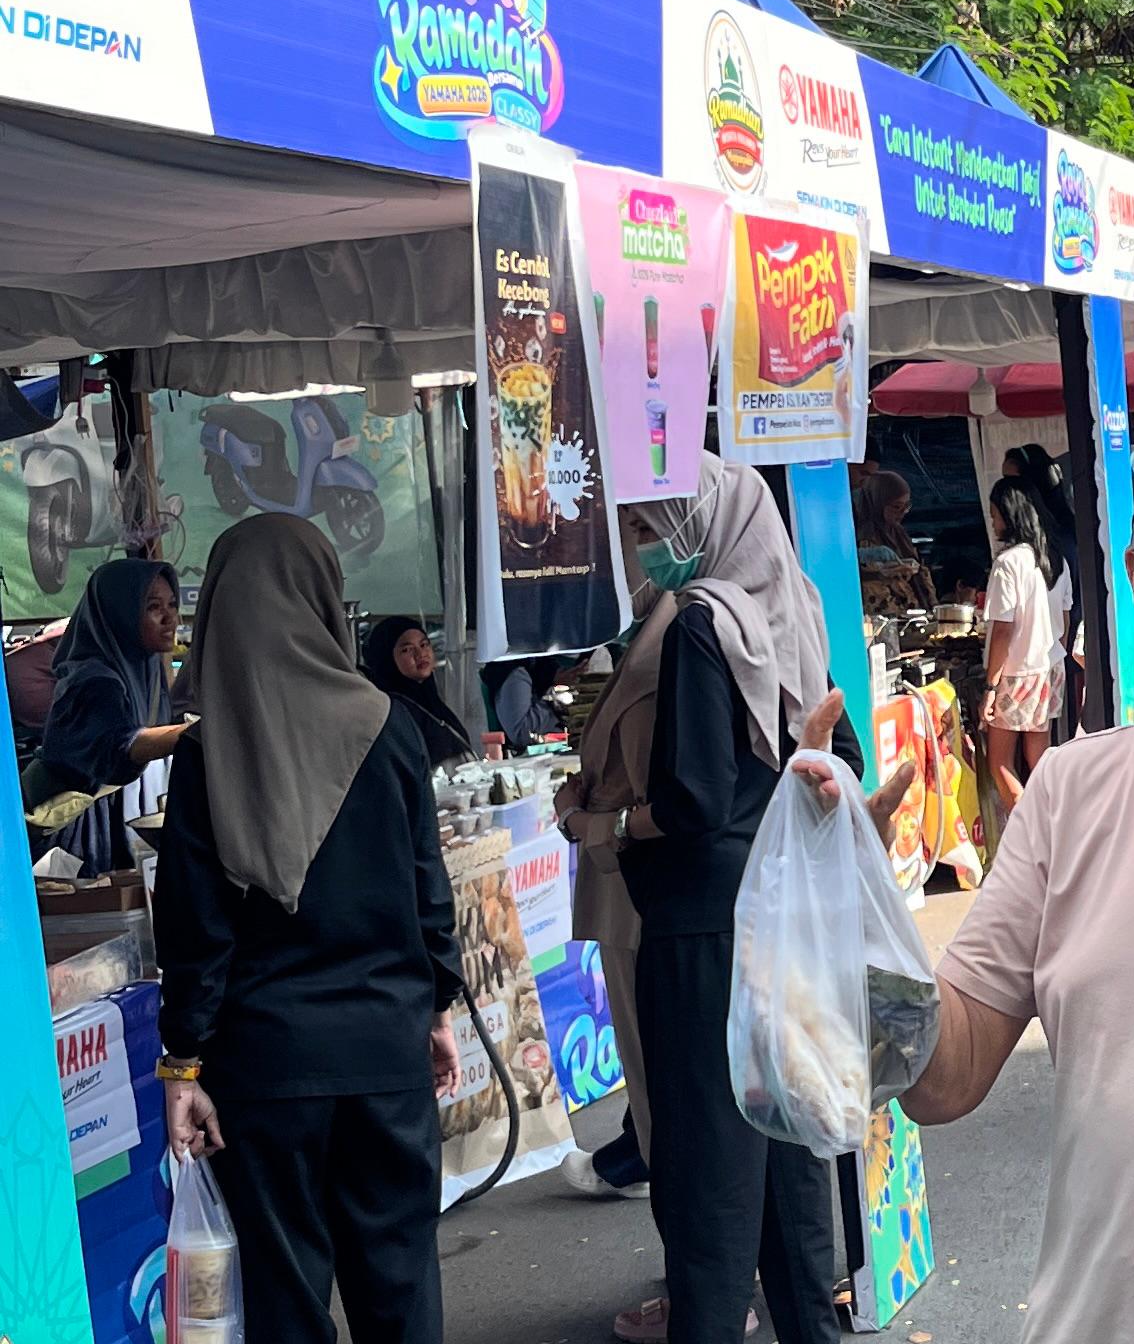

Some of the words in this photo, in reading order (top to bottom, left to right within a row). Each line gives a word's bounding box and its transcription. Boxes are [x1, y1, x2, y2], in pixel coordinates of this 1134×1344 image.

[55, 17, 142, 62] DEPAN
[423, 86, 465, 103] YAMAHA
[466, 85, 488, 103] 2026
[796, 72, 863, 141] YAMAHA
[496, 96, 539, 128] CLASSY
[912, 123, 954, 175] Instant
[622, 222, 686, 261] matcha
[496, 248, 510, 273] Es
[510, 250, 551, 278] Cendol
[497, 277, 551, 309] Kecebong
[514, 850, 561, 893] YAMAHA
[461, 1013, 505, 1046] HAGA
[69, 1114, 109, 1143] DEPAN
